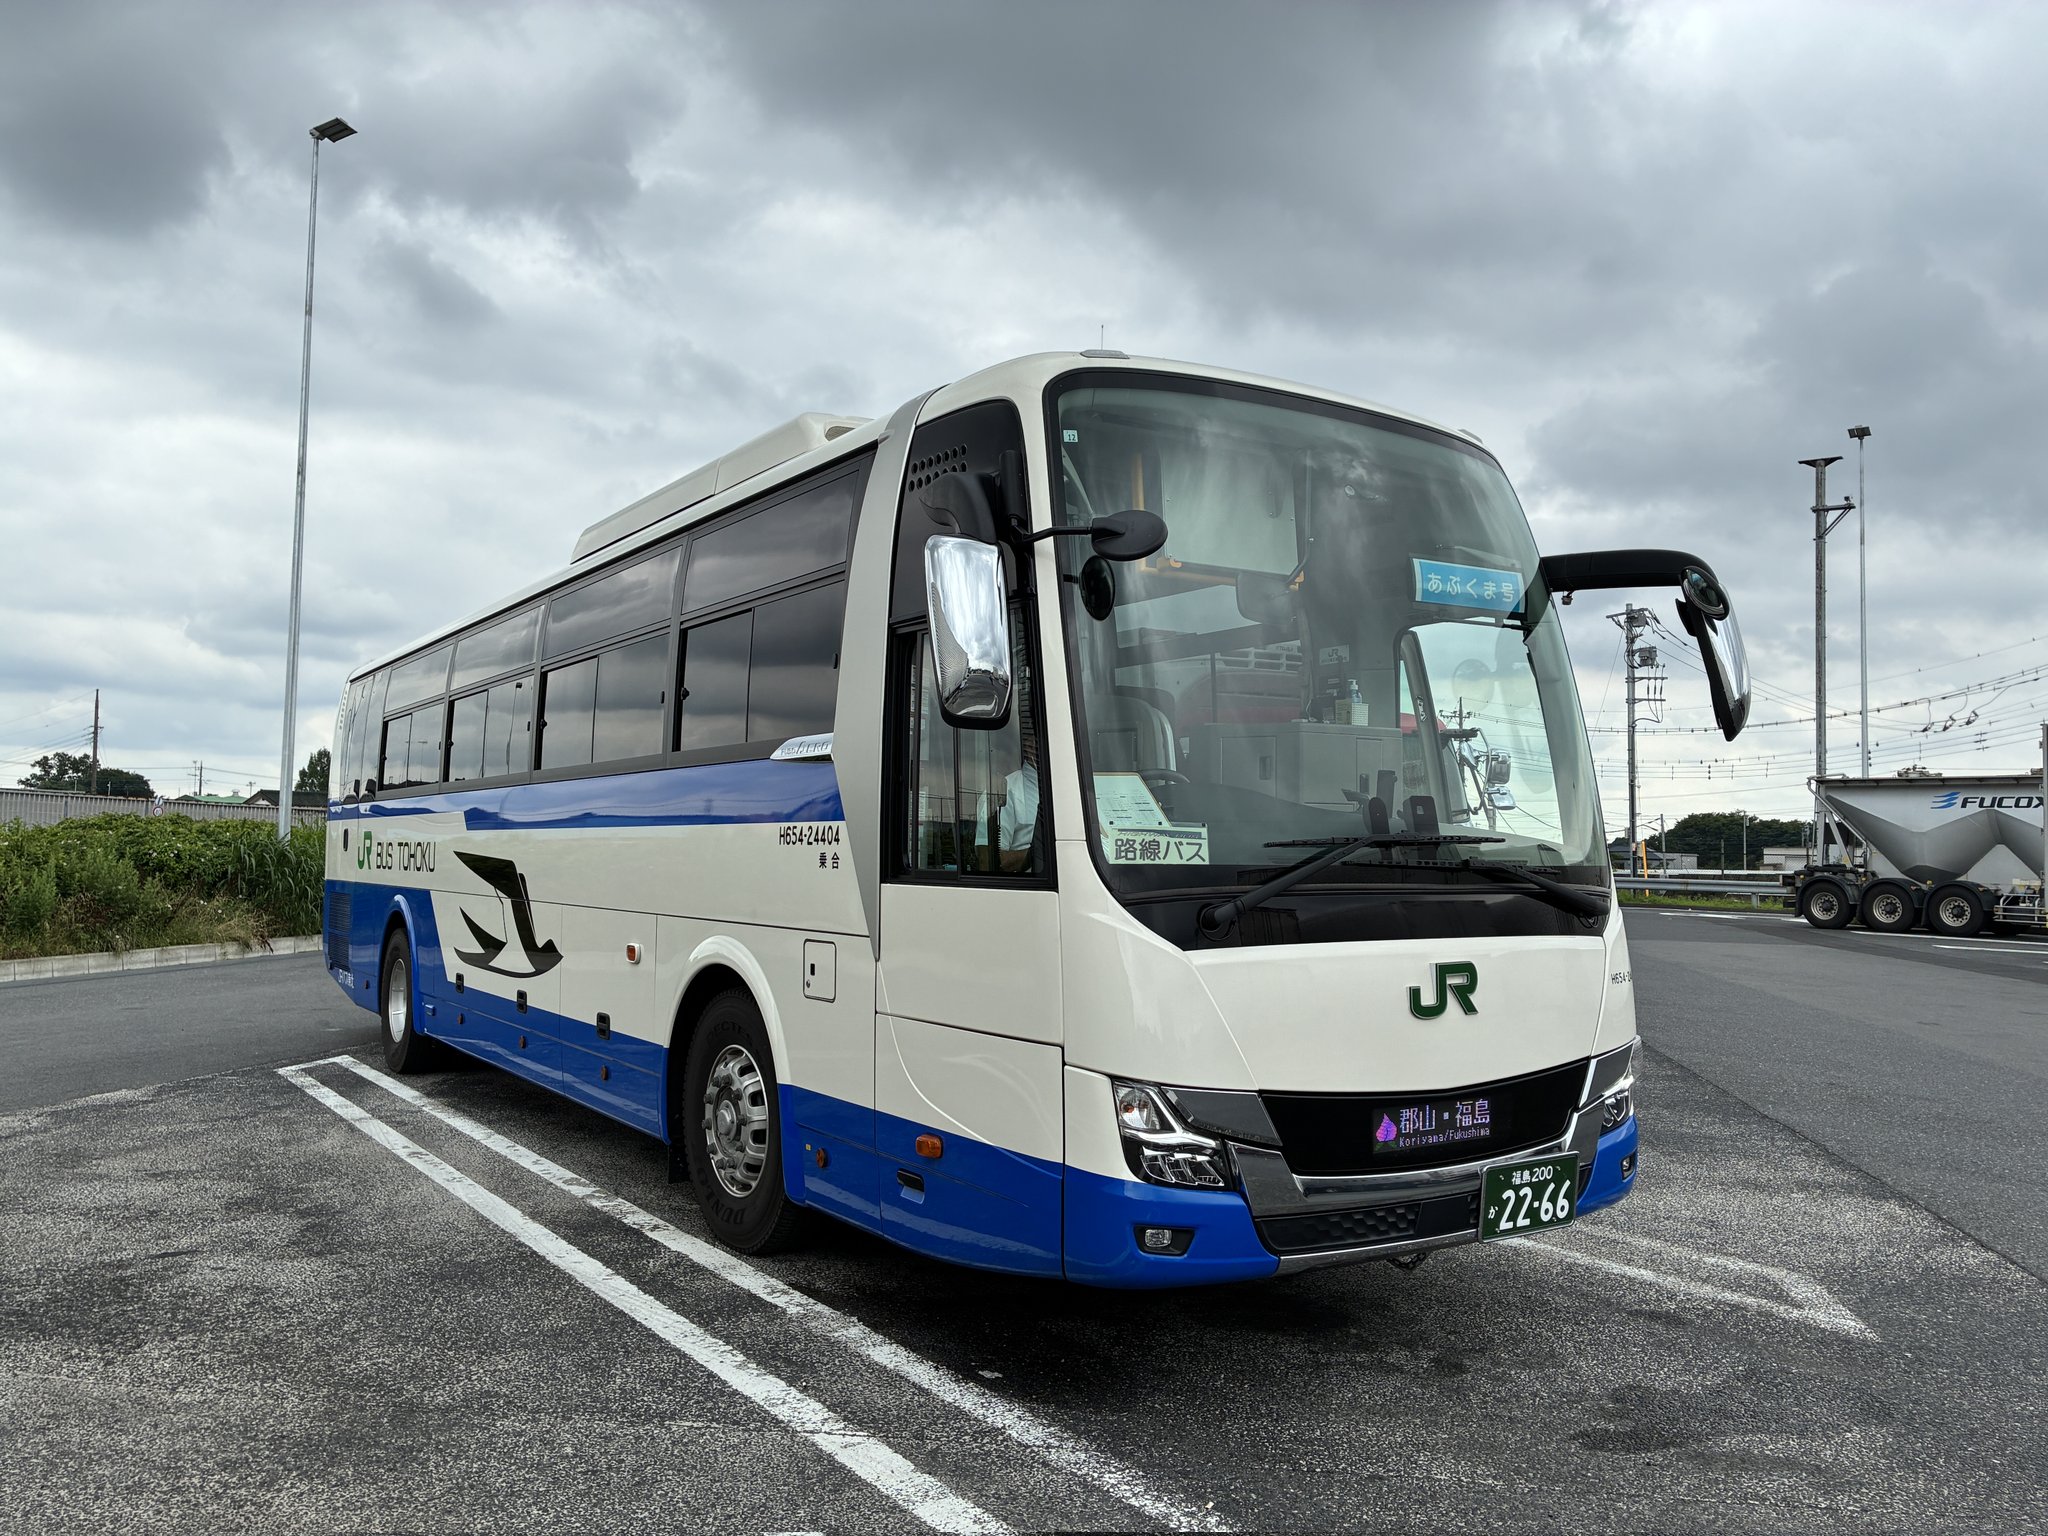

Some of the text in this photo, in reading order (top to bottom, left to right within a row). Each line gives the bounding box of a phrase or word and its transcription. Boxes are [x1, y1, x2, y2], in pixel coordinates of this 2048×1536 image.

[1427, 572, 1515, 602] あぶくま号
[779, 825, 841, 846] H654-24404
[1115, 838, 1207, 863] 路線バス
[358, 831, 436, 873] JR BUS TOHOKU
[818, 851, 841, 869] 乗合
[1408, 961, 1479, 1020] JR
[1400, 1098, 1490, 1134] 郡山・福島
[1400, 1127, 1490, 1148] Koriyama/Fukushima
[1487, 1179, 1571, 1231] か 22-66
